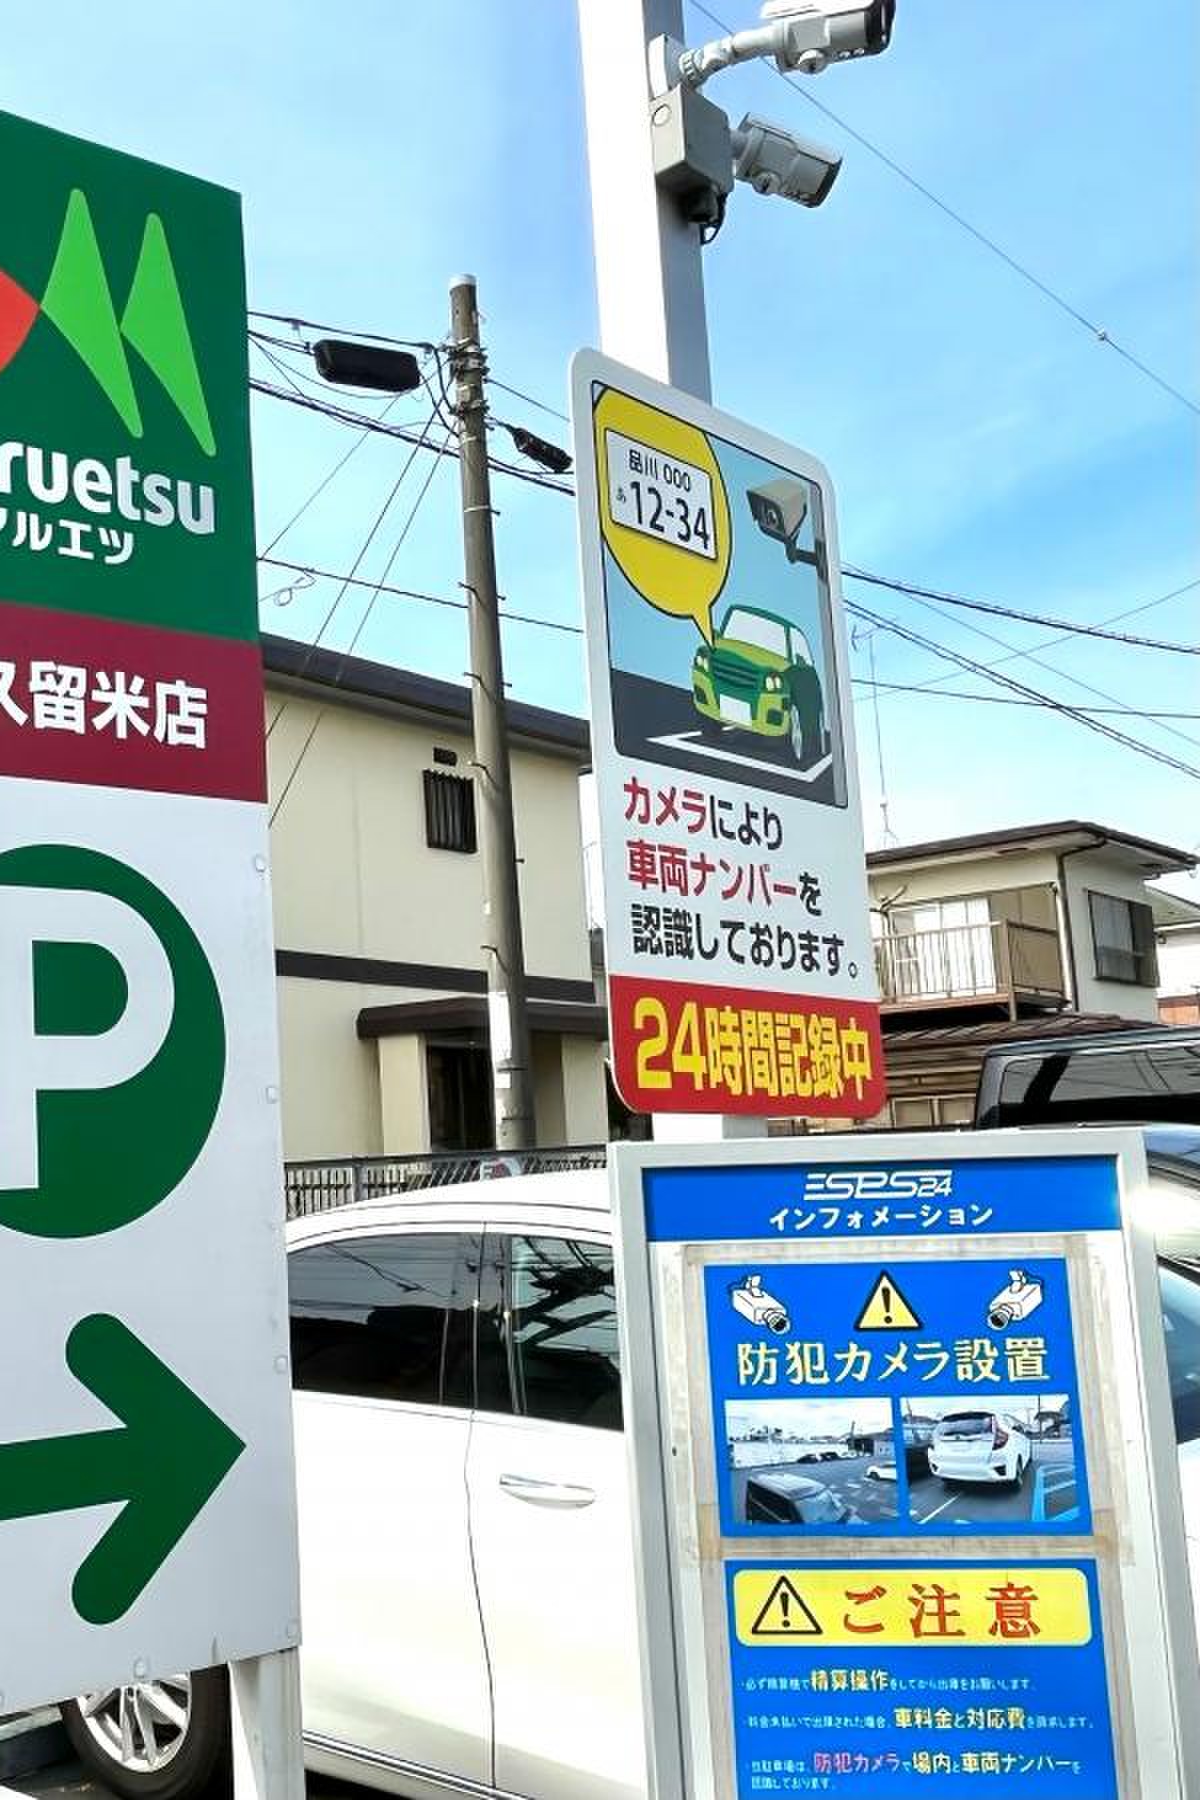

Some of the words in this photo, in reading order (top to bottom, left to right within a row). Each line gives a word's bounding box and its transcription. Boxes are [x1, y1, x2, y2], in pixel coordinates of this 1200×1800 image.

[629, 449, 658, 481] 品川
[663, 463, 690, 492] 000
[630, 481, 709, 550] 12-34
[623, 776, 784, 850] カメラにより
[626, 838, 822, 917] 車両ナンバーを
[630, 902, 858, 979] 認識しております。
[634, 997, 873, 1101] 24時間記録中
[768, 1204, 994, 1232] インフォメーション
[736, 1336, 1051, 1387] 防犯カメラ設置
